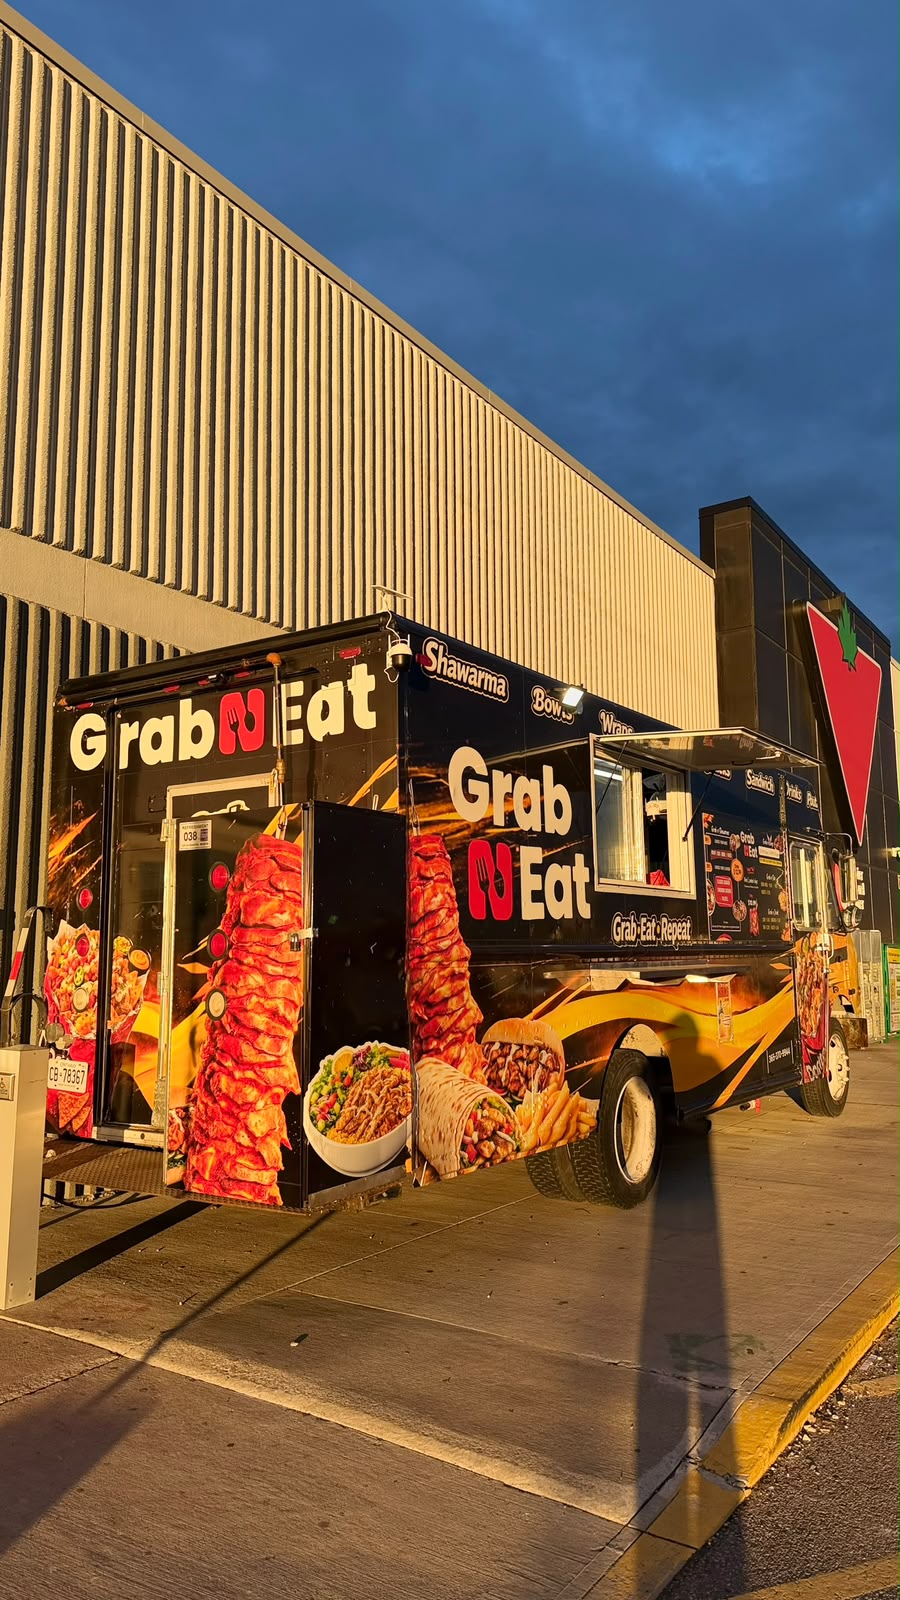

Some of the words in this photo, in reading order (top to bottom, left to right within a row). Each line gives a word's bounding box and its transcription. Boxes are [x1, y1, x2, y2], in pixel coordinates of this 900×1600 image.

[423, 639, 507, 698] Shawarma
[70, 697, 216, 772] Grab
[272, 663, 377, 747] Eat
[448, 746, 573, 836] Grab
[746, 768, 775, 794] Sandwich
[183, 831, 198, 841] 038
[740, 831, 755, 845] Grab
[749, 845, 759, 858] Eat
[519, 845, 592, 921] Eat
[613, 914, 637, 942] Grab
[640, 917, 656, 941] Eat
[661, 916, 691, 945] Repeat
